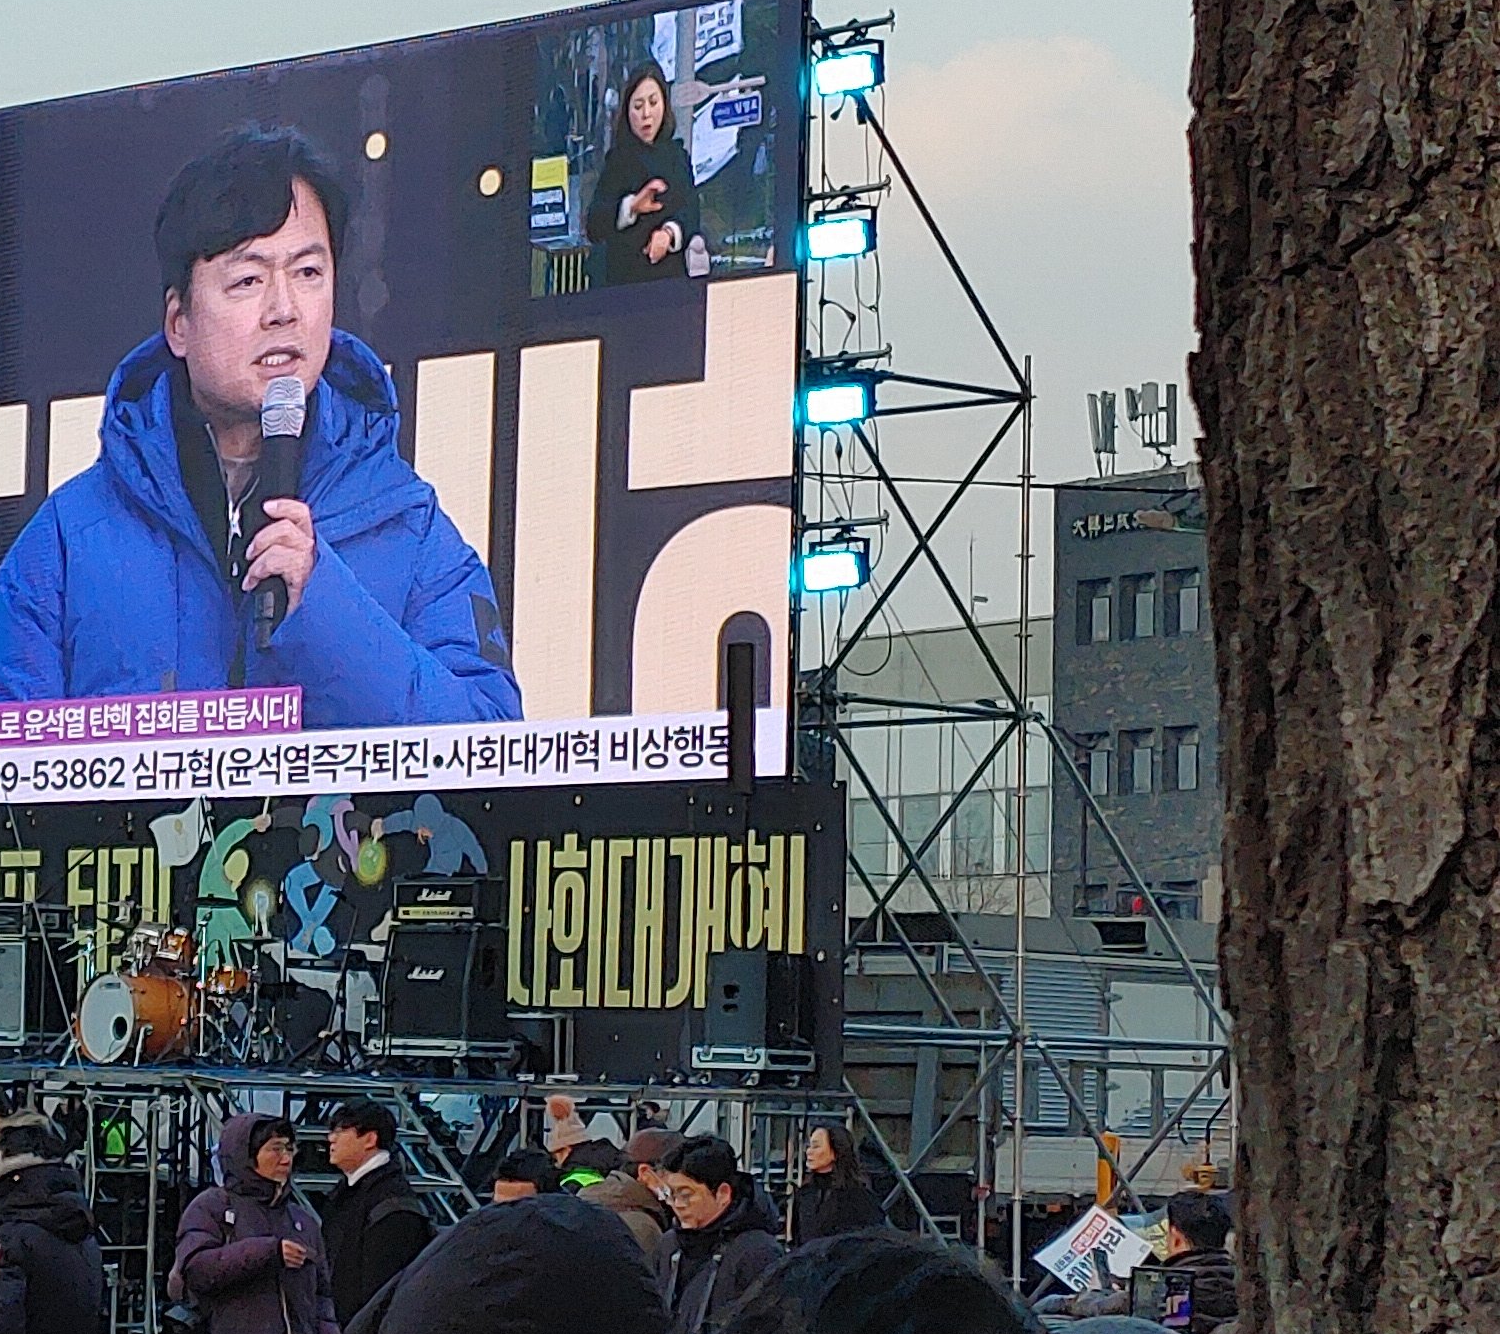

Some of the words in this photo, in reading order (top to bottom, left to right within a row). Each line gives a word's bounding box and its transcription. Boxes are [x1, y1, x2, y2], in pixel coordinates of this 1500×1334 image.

[24, 703, 85, 740] 윤석열
[89, 701, 131, 737] 탄핵
[135, 699, 199, 734] 집회를
[202, 694, 299, 732] 만듭시다!
[610, 723, 730, 769] 비상행동
